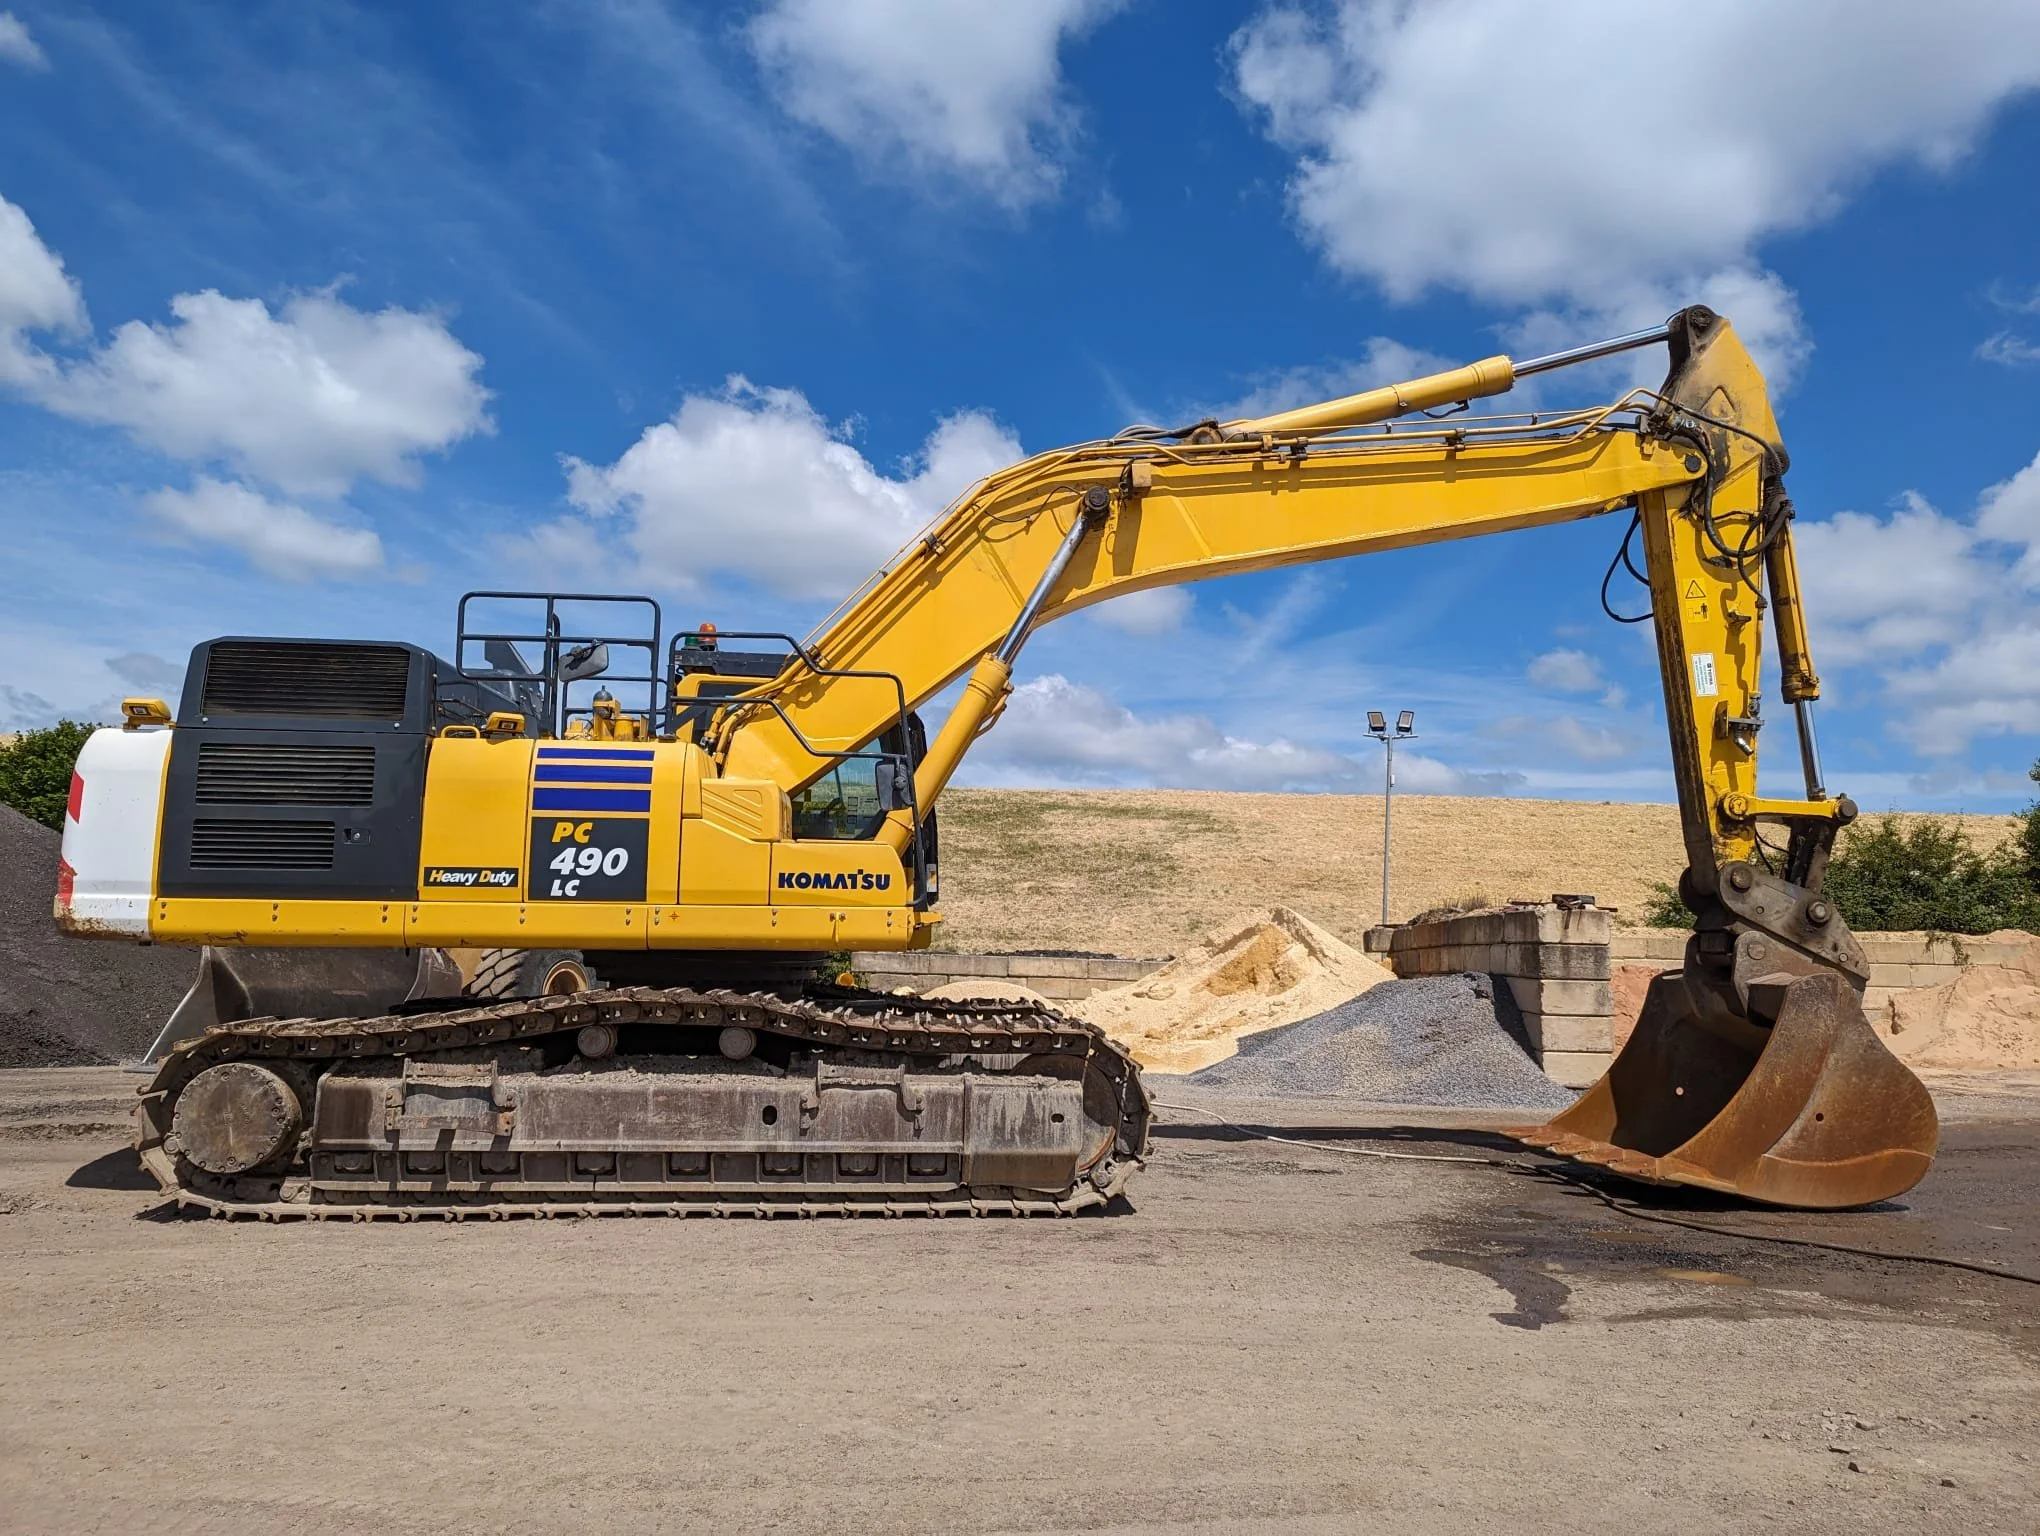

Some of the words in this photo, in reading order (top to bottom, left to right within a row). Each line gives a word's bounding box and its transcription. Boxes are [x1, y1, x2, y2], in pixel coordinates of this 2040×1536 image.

[552, 822, 593, 843] PC
[550, 848, 628, 876] 490
[429, 870, 478, 886] Heavy
[479, 870, 515, 886] Duty
[550, 880, 580, 896] LC
[778, 869, 890, 890] KOMATSU
